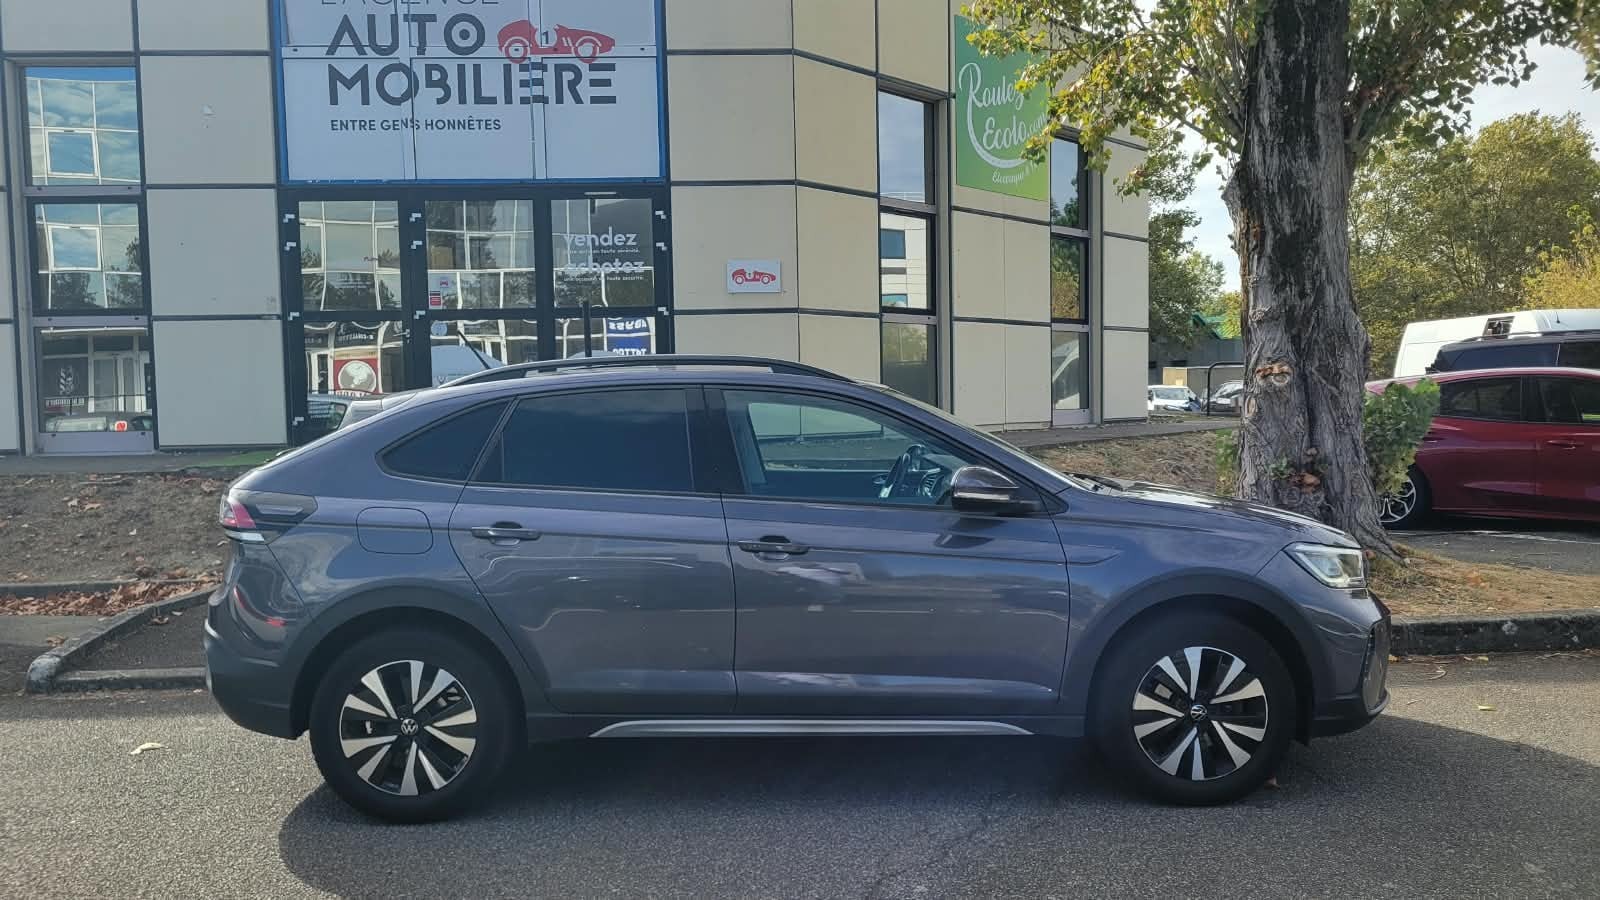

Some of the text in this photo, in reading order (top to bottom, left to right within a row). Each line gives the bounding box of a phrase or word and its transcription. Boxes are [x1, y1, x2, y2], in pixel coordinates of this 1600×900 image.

[325, 13, 486, 56] AUTO
[330, 115, 502, 131] ENTRE GENS HONNÊTES
[563, 225, 638, 247] vendez
